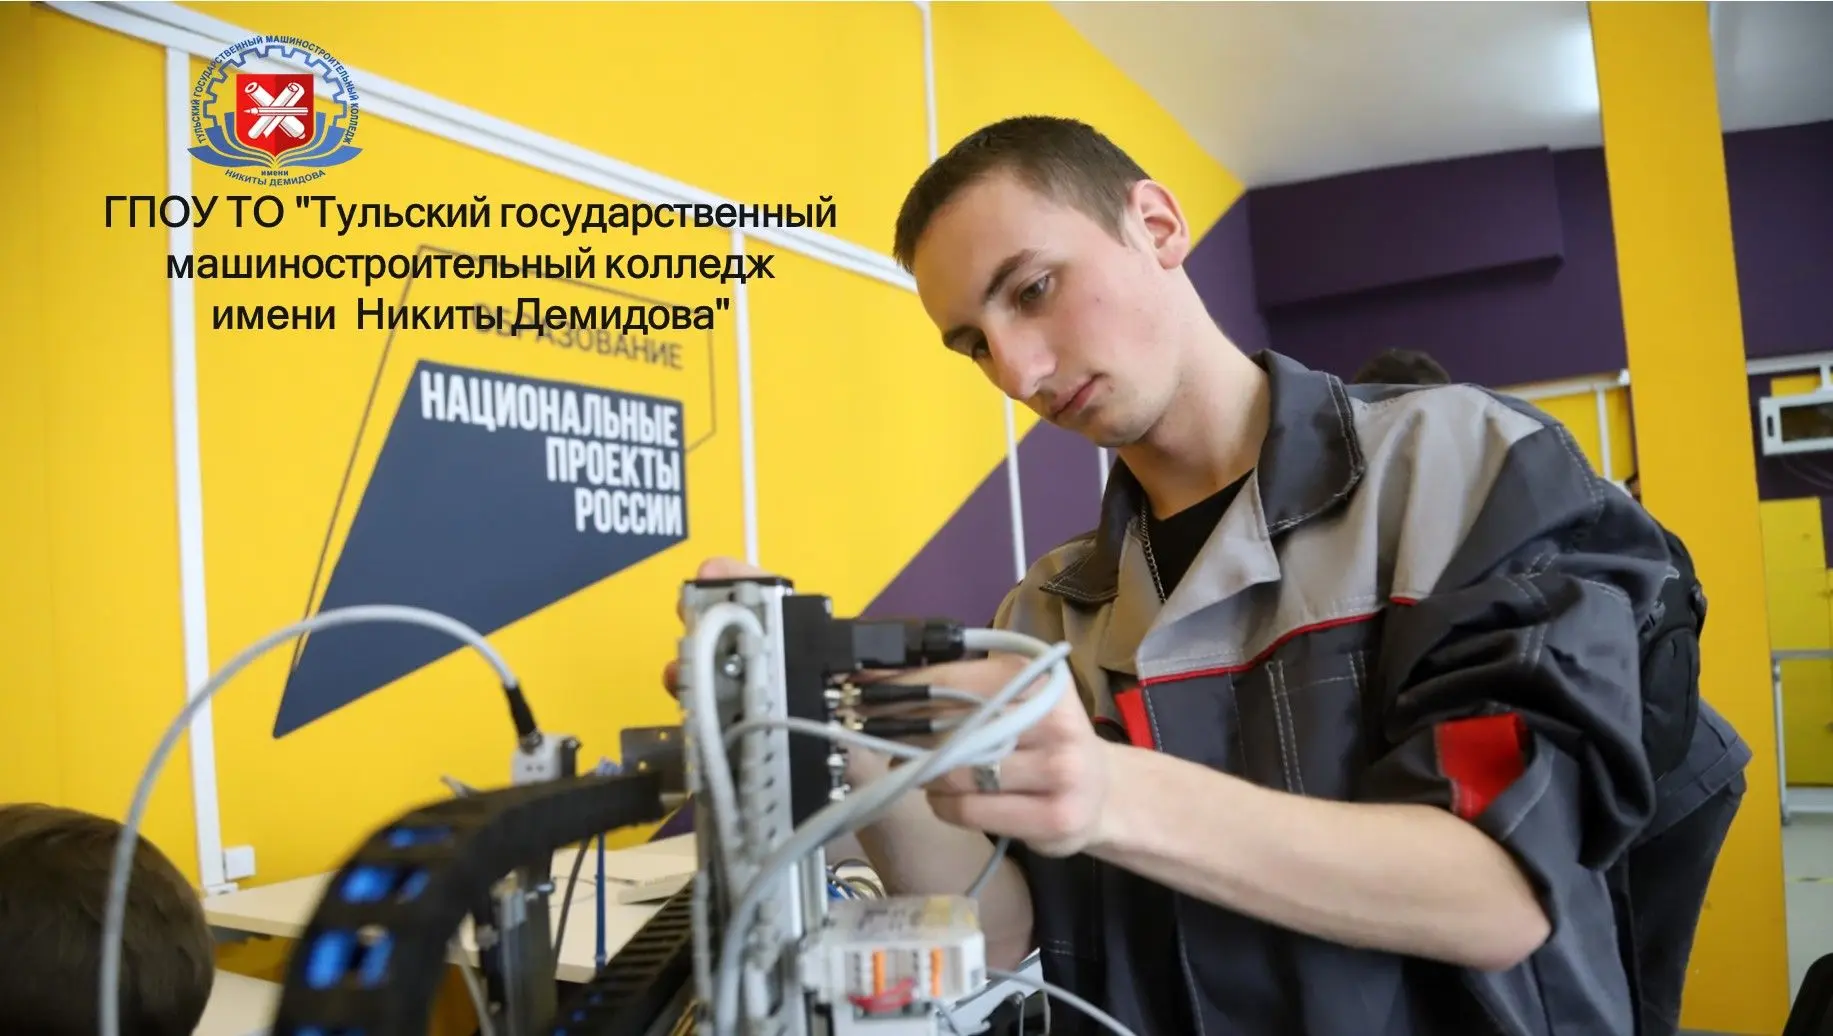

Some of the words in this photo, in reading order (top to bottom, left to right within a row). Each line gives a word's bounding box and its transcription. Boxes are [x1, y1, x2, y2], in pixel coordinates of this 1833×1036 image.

[420, 370, 679, 447] НАЦИОНАЛЬНЫЕ
[546, 436, 681, 491] ПРОЕКТЫ
[574, 487, 682, 536] РОССИИ
